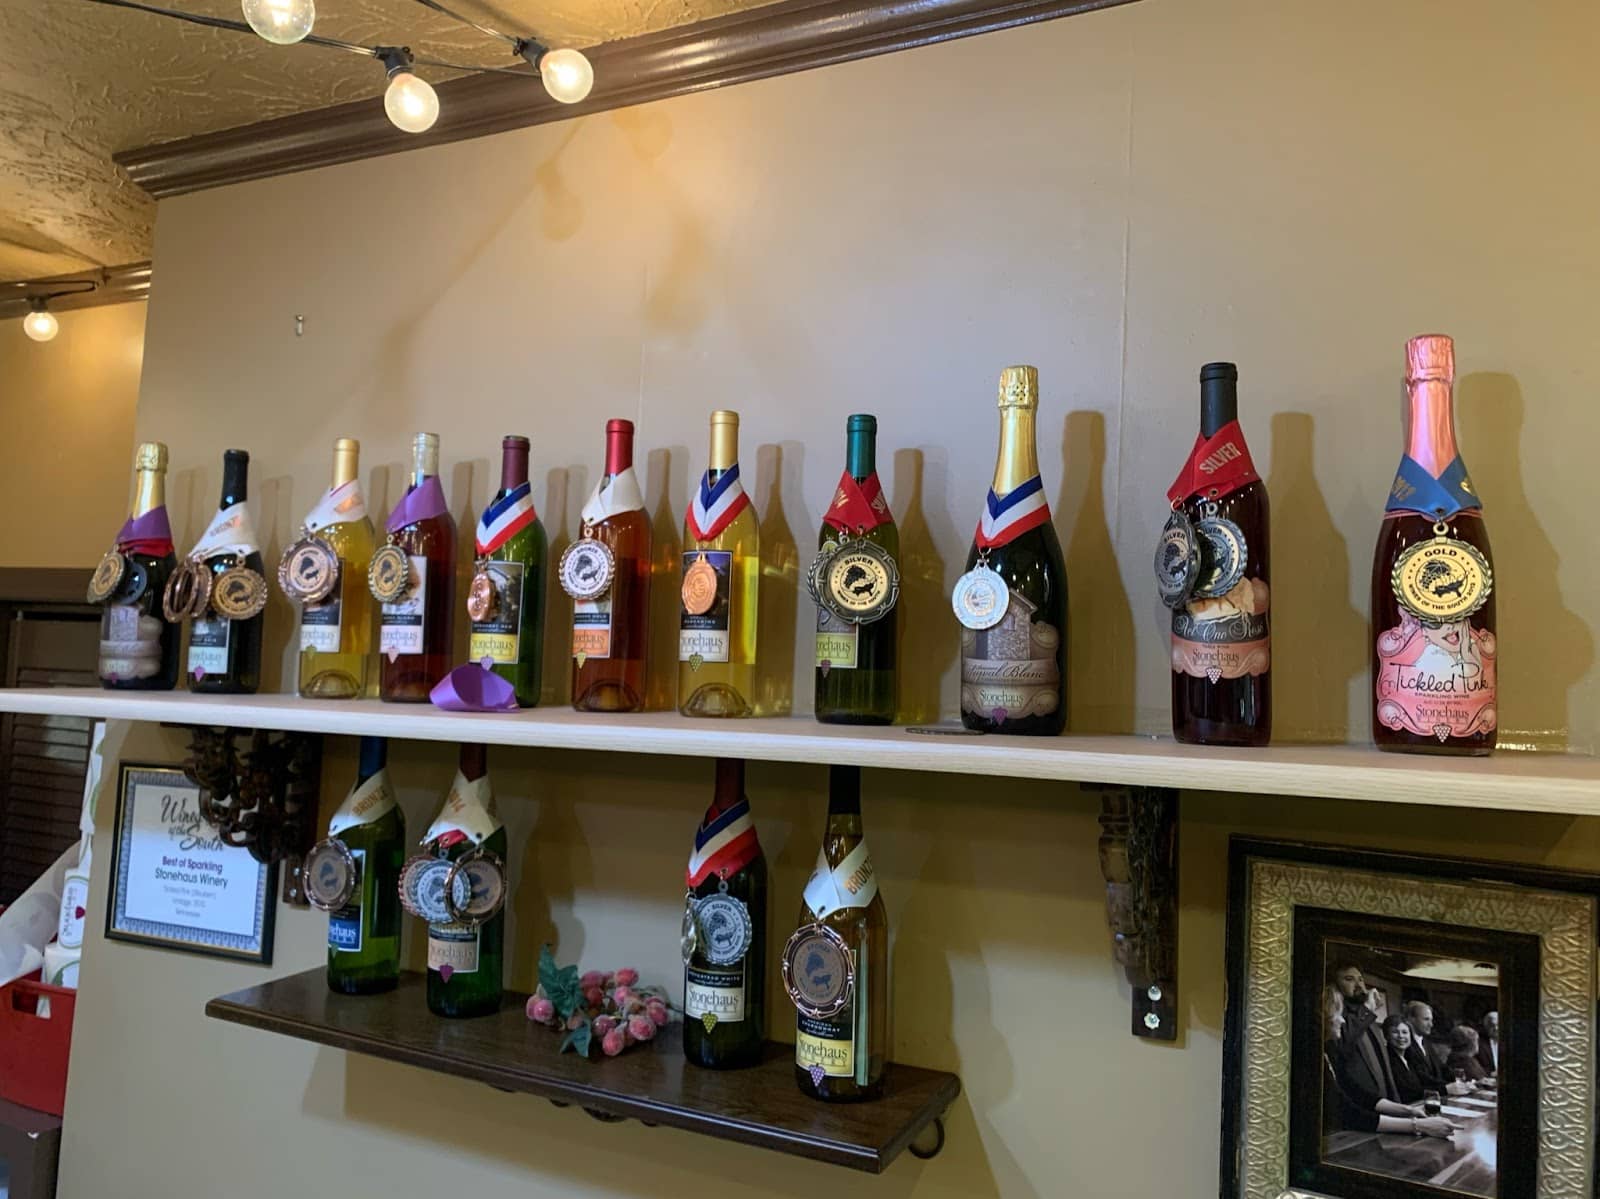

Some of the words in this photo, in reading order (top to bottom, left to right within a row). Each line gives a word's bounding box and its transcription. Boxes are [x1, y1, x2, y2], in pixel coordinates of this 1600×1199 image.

[1199, 442, 1242, 474] SILVER
[844, 557, 874, 566] SILVER
[1424, 548, 1458, 558] GOLD
[1192, 648, 1240, 662] Stonehaus
[1003, 661, 1044, 680] Blanc
[1389, 662, 1456, 693] Tickled
[1451, 661, 1489, 693] Pink
[979, 687, 1024, 703] Stonehaus
[1415, 703, 1470, 719] Stonehaus
[179, 824, 224, 851] South
[162, 855, 178, 867] Best
[179, 858, 186, 868] of
[187, 859, 223, 875] Sparkling
[155, 867, 198, 884] Stonehaus
[199, 873, 228, 889] Winery
[711, 903, 732, 912] SILVER
[689, 984, 738, 1006] Stonehaus
